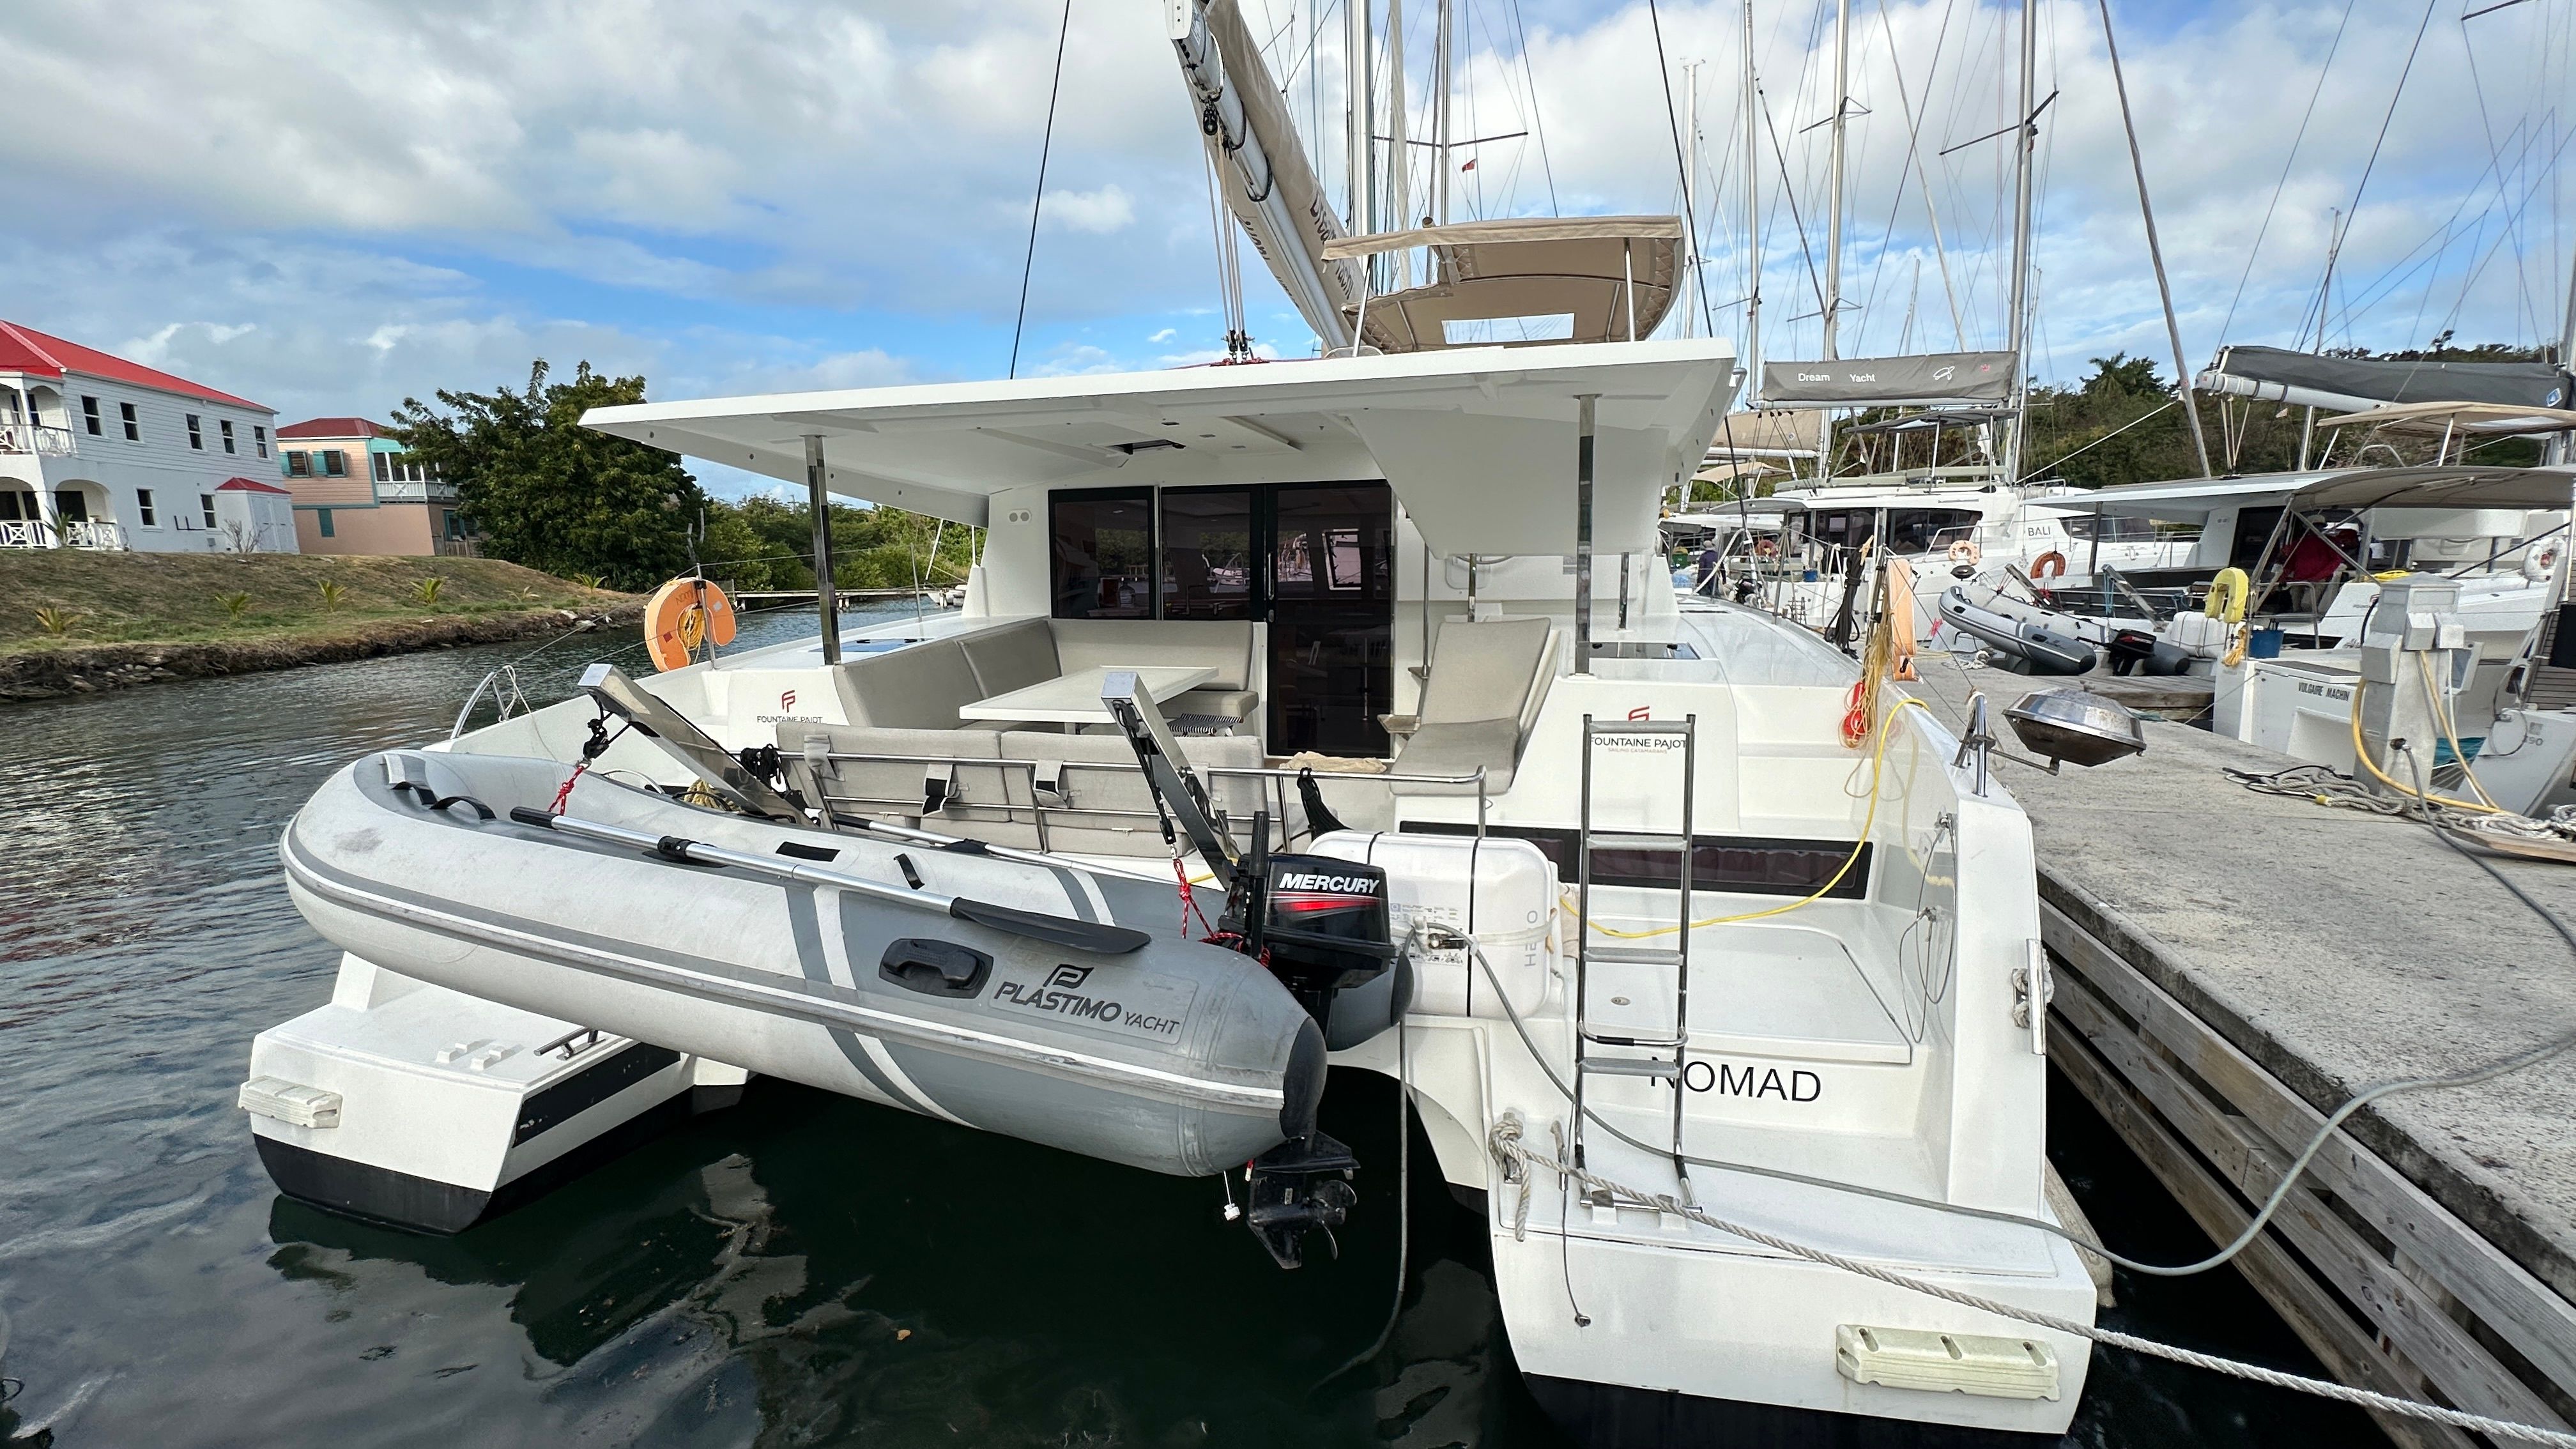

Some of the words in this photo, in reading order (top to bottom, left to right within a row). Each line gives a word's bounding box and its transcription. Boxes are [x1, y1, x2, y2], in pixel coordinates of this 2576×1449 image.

[1798, 373, 1830, 381] Dream
[1849, 373, 1876, 383] Yacht
[2028, 526, 2051, 536] BALI
[1654, 739, 1686, 750] PAJOT
[1278, 873, 1380, 894] MERCURY
[993, 981, 1123, 1022] PLASTIMO
[1124, 1011, 1180, 1034] YACHT
